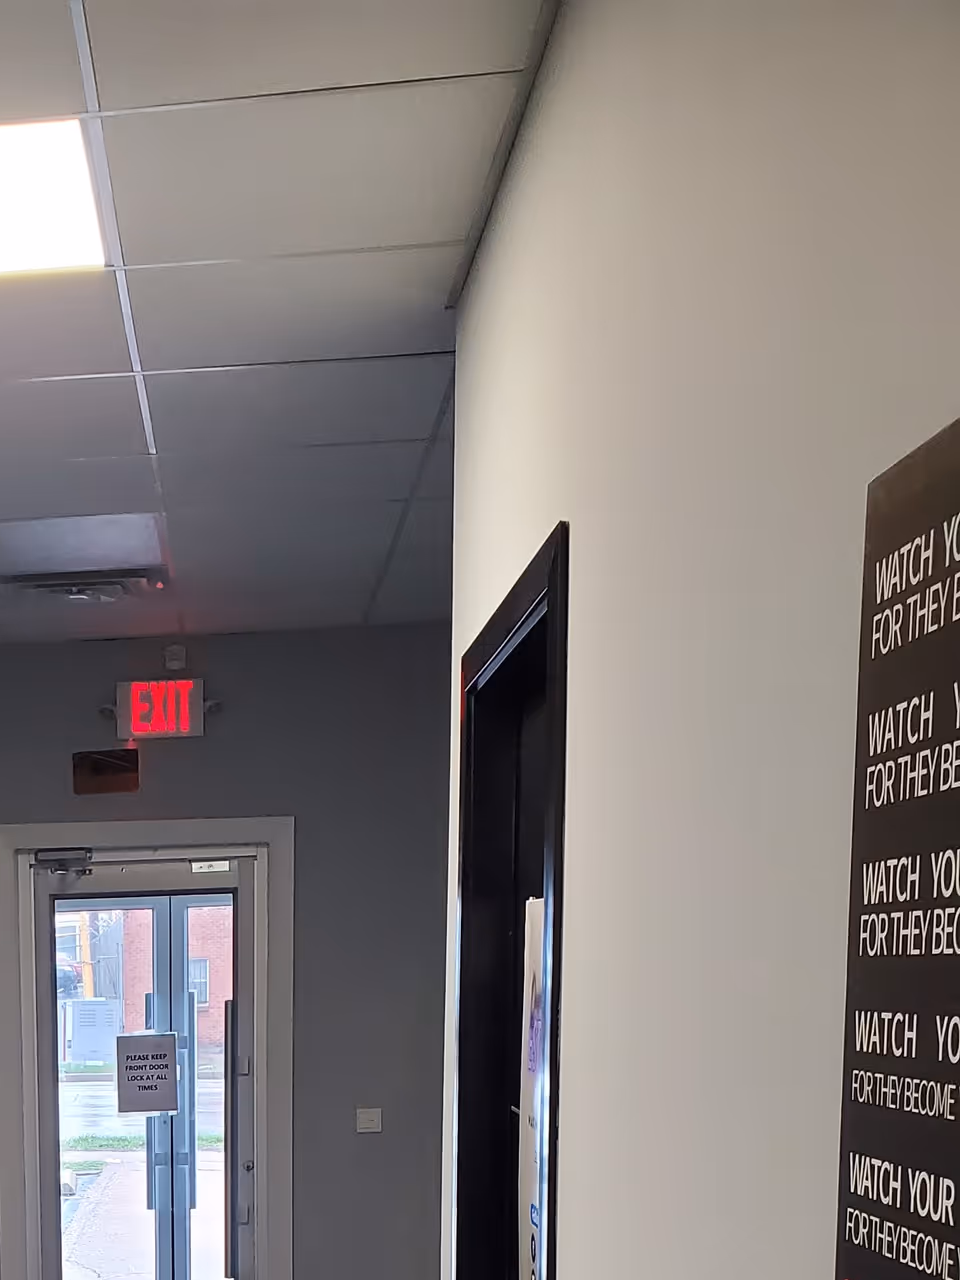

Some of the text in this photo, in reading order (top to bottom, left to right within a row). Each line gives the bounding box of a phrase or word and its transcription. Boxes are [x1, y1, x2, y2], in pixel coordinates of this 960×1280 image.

[875, 528, 935, 604] WATCH
[871, 603, 903, 660] FOR
[906, 577, 951, 642] THEY
[131, 680, 193, 733] EXIT
[868, 691, 934, 757] WATCH
[865, 760, 896, 810] FOR
[897, 746, 940, 802] THEY
[862, 854, 920, 906] WATCH
[859, 913, 889, 957] FOR
[890, 909, 931, 956] THEY
[126, 1053, 168, 1062] PLEASE KEEP
[855, 1010, 960, 1064] WATCH YO
[125, 1063, 169, 1072] FRONT DOOR
[127, 1074, 145, 1082] LOCK
[137, 1084, 158, 1092] TIMES
[851, 1069, 874, 1105] FOR
[874, 1073, 904, 1110] THEY
[903, 1077, 957, 1120] BECOME
[849, 1151, 955, 1227] WATCH YOUR
[845, 1207, 869, 1249] FOR
[869, 1215, 900, 1260] THEY
